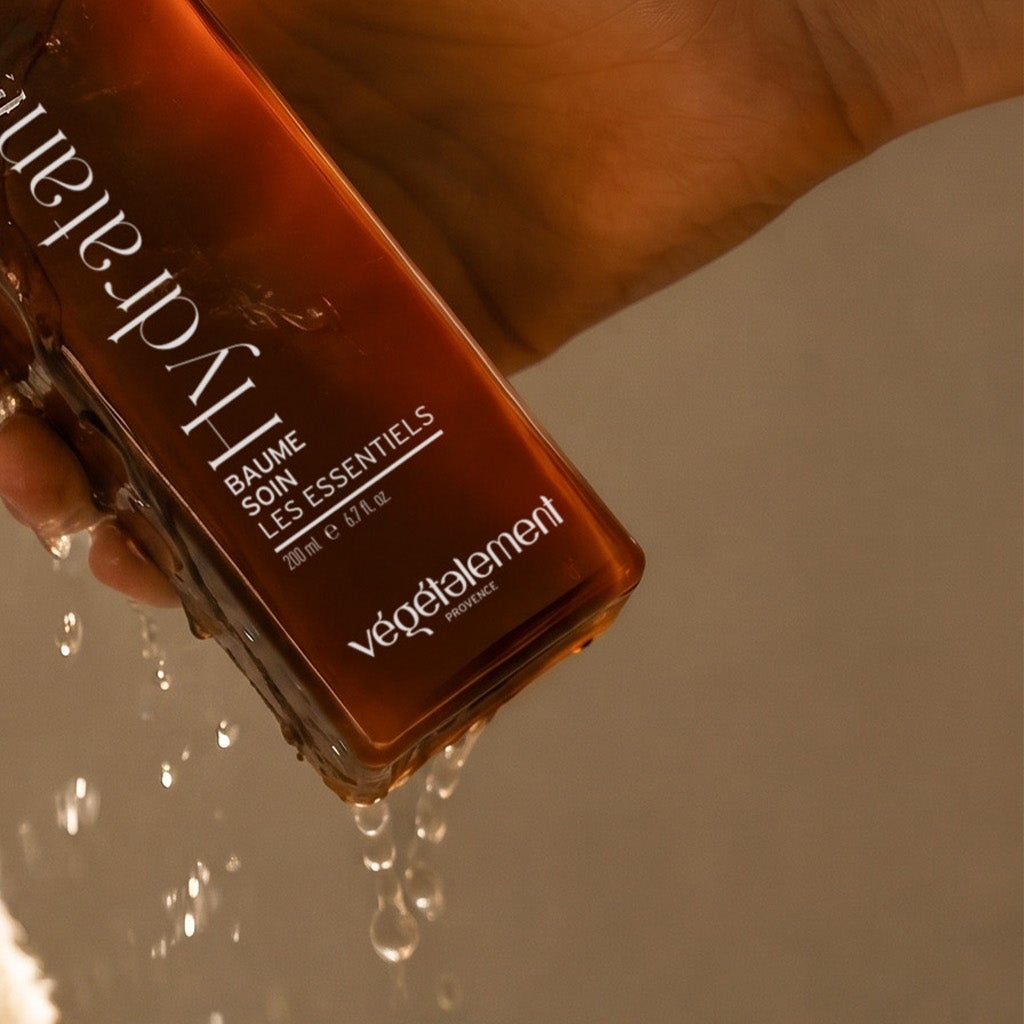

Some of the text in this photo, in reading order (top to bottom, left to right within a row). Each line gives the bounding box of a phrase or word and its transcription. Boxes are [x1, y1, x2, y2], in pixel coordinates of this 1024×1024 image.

[223, 429, 307, 497] BAUME
[241, 468, 299, 517] SOIN
[257, 405, 434, 540] LES ESSENTIELS
[282, 547, 307, 571] 200
[304, 536, 323, 556] ml
[343, 505, 362, 528] 6.7
[444, 580, 499, 623] PROVENCE
